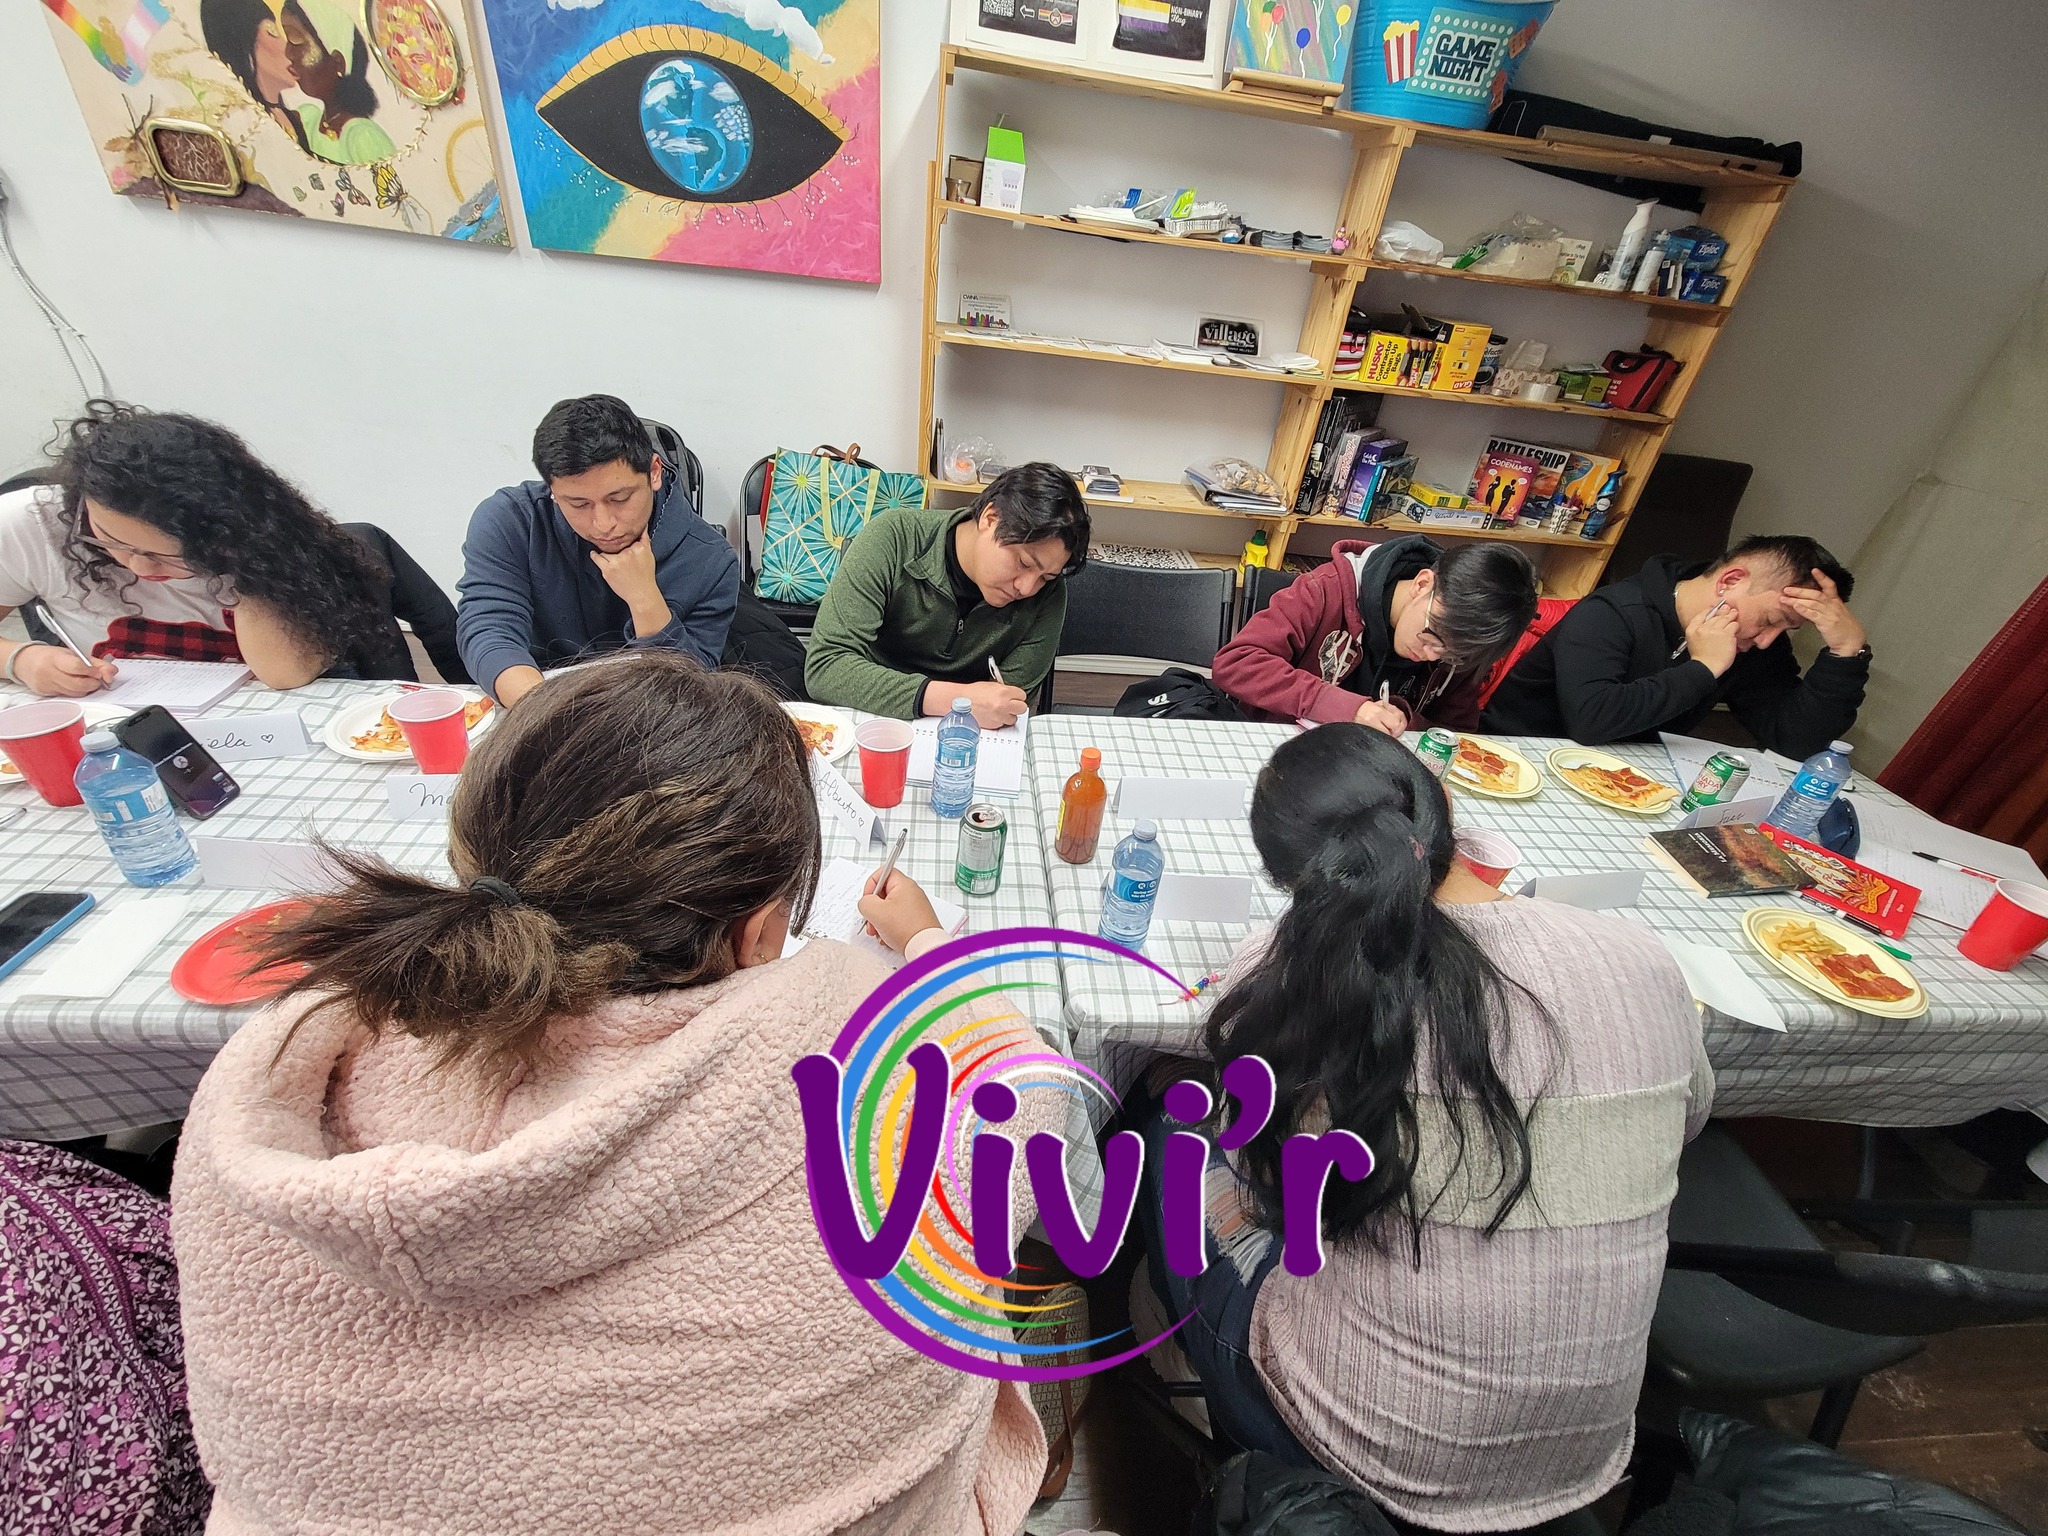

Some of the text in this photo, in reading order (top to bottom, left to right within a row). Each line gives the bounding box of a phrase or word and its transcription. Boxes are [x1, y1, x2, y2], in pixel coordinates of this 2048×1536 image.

[1171, 6, 1203, 19] NON-BINARY
[1171, 14, 1186, 26] Flag
[1436, 33, 1497, 61] GAME
[1428, 55, 1489, 83] NIGHT
[1698, 244, 1719, 255] Ziploc
[1701, 278, 1721, 289] Ziploc
[1204, 323, 1256, 348] village
[1367, 341, 1385, 380] HUSKY
[1376, 340, 1393, 381] Contractor
[1382, 343, 1399, 379] Clean-Up
[1391, 353, 1402, 373] Bags
[1454, 380, 1473, 389] GLAD
[1486, 439, 1566, 469] BATTLESHIP
[1490, 458, 1534, 474] CODENAMES
[204, 732, 252, 749] iela
